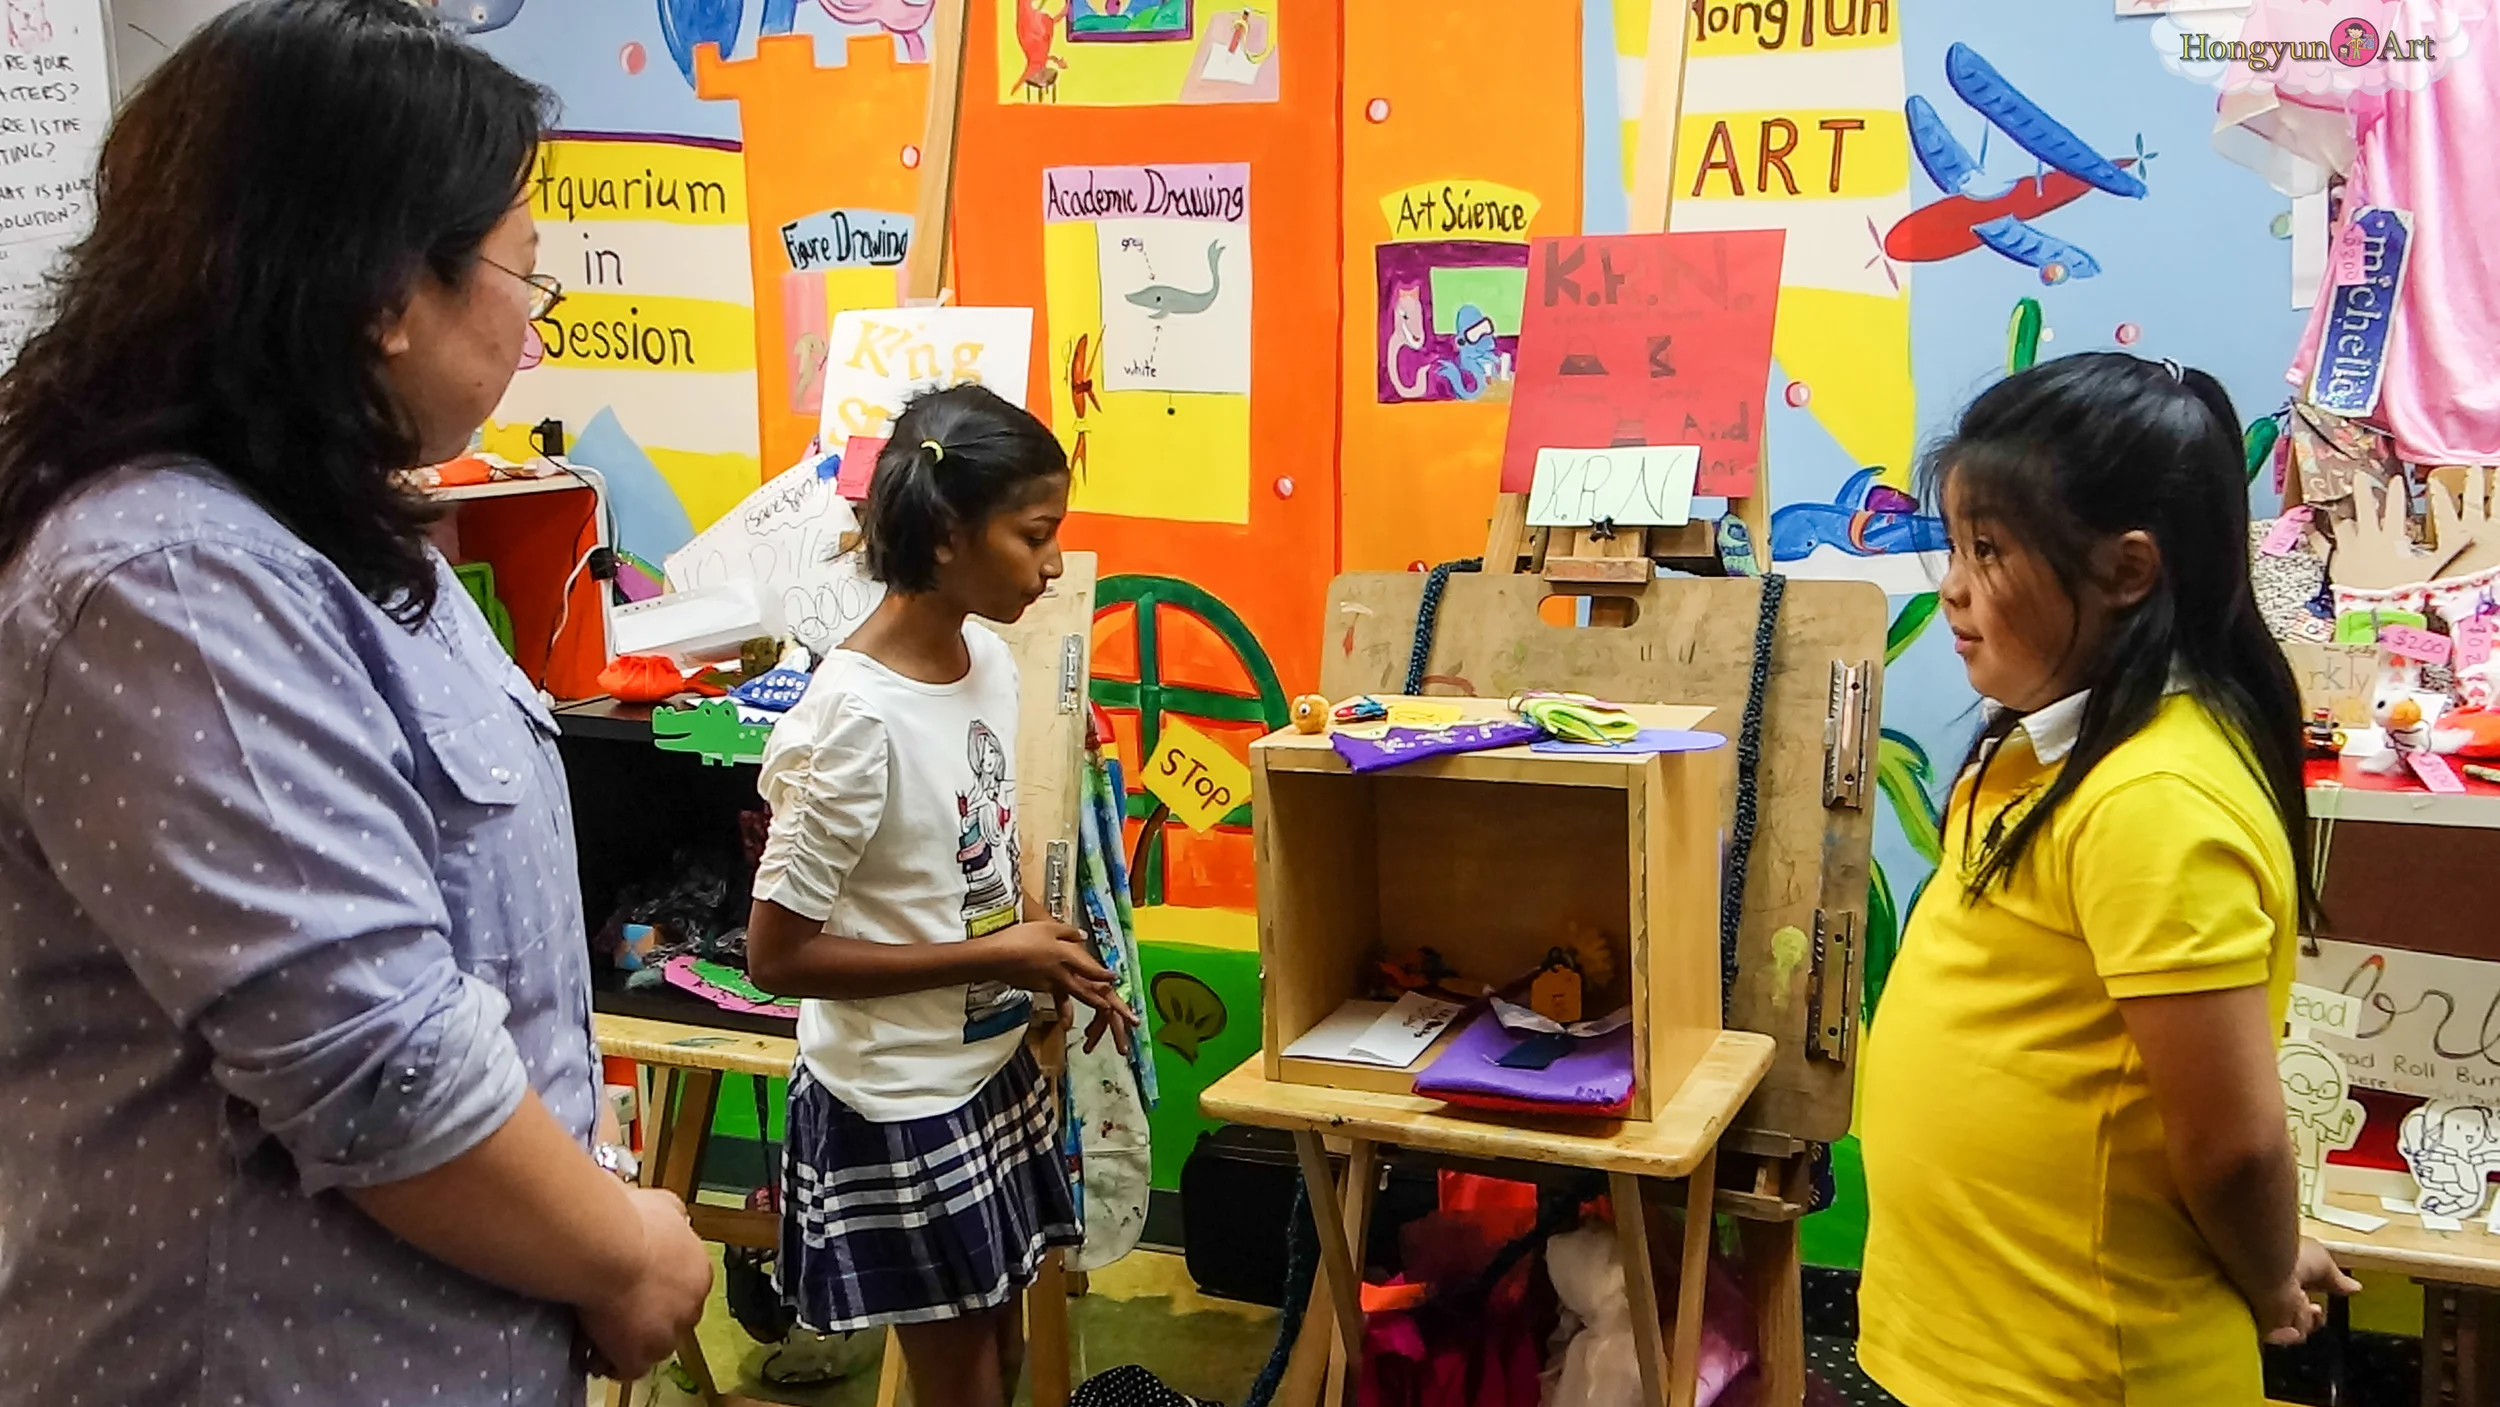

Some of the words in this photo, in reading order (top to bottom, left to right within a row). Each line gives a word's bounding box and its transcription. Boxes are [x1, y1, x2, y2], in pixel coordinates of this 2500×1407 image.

[1692, 118, 1865, 196] ART
[1047, 170, 1138, 218] Academic
[1144, 168, 1244, 222] Drawing
[1396, 190, 1436, 235] Art
[1442, 186, 1528, 233] Science
[0, 203, 82, 232] OLUTION?
[583, 233, 623, 286] in
[782, 221, 830, 271] Figure
[830, 211, 909, 266] Drawing
[1121, 237, 1144, 252] grey
[1124, 360, 1157, 378] white
[2306, 656, 2371, 698] rkly
[2289, 994, 2347, 1027] ead
[2393, 1055, 2435, 1078] Roll
